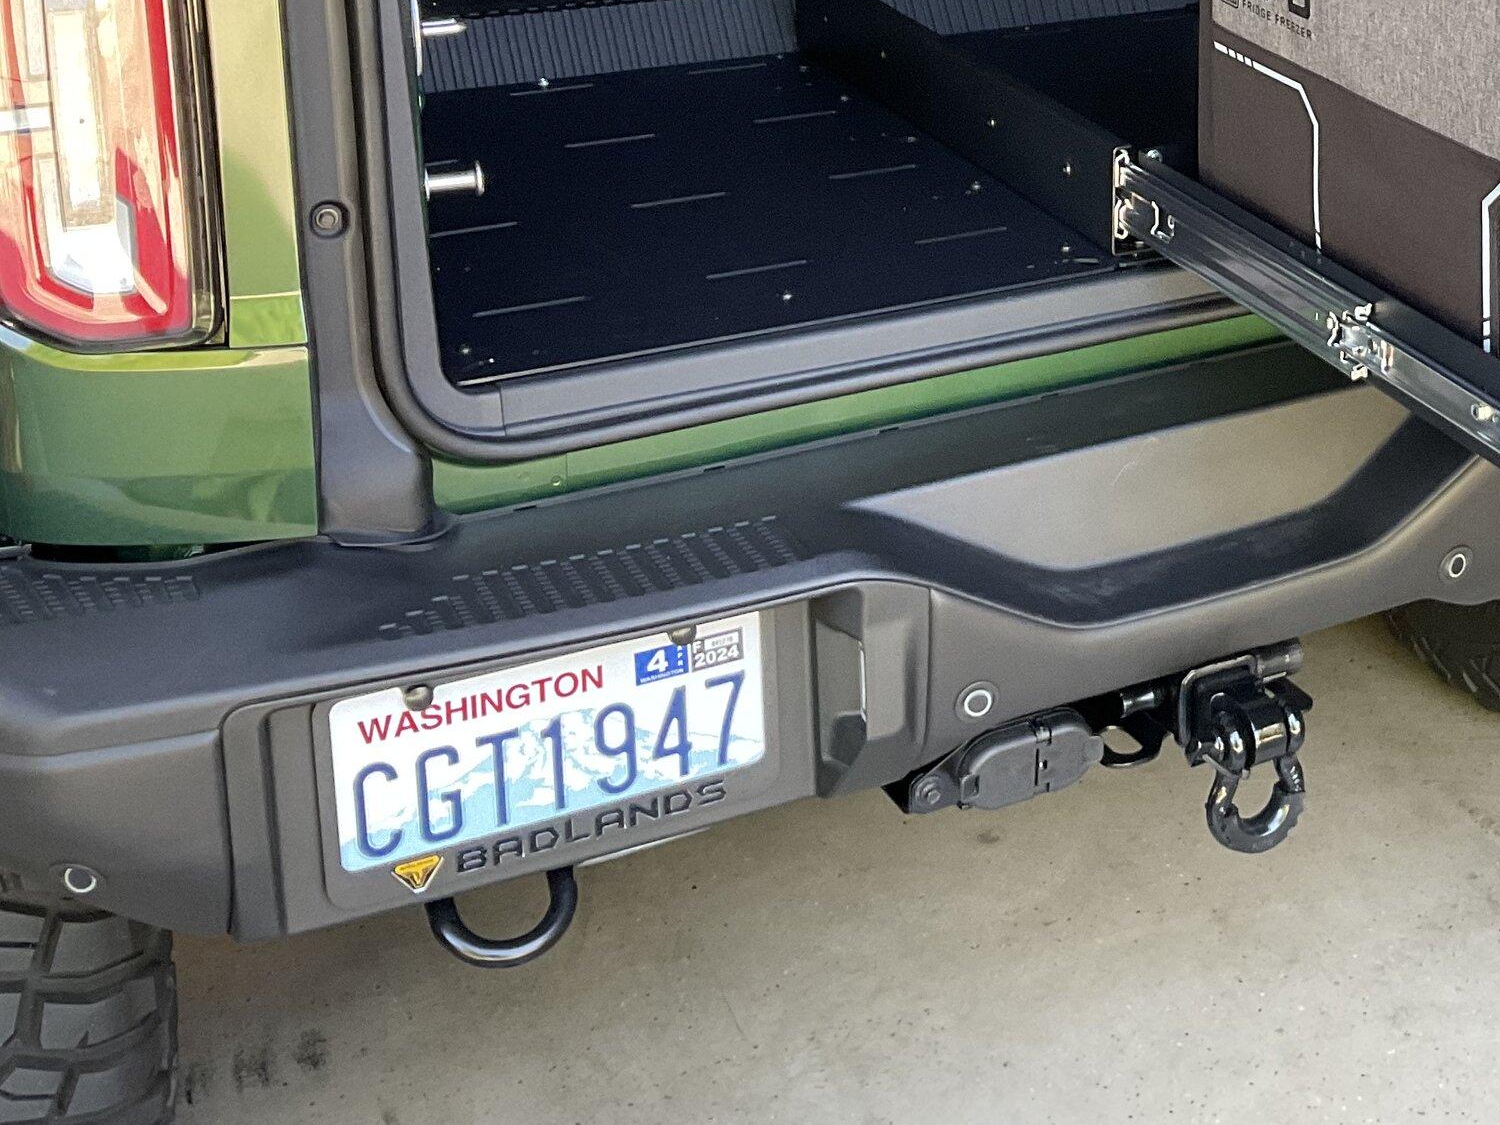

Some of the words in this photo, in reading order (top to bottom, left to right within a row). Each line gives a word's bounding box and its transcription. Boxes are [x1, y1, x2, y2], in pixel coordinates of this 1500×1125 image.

[1274, 13, 1313, 40] FREEZER
[646, 649, 669, 673] 4
[694, 644, 740, 668] 2024
[356, 664, 604, 745] WASHINGTON
[352, 670, 747, 859] CGT1947
[456, 778, 729, 874] BADLANDS
